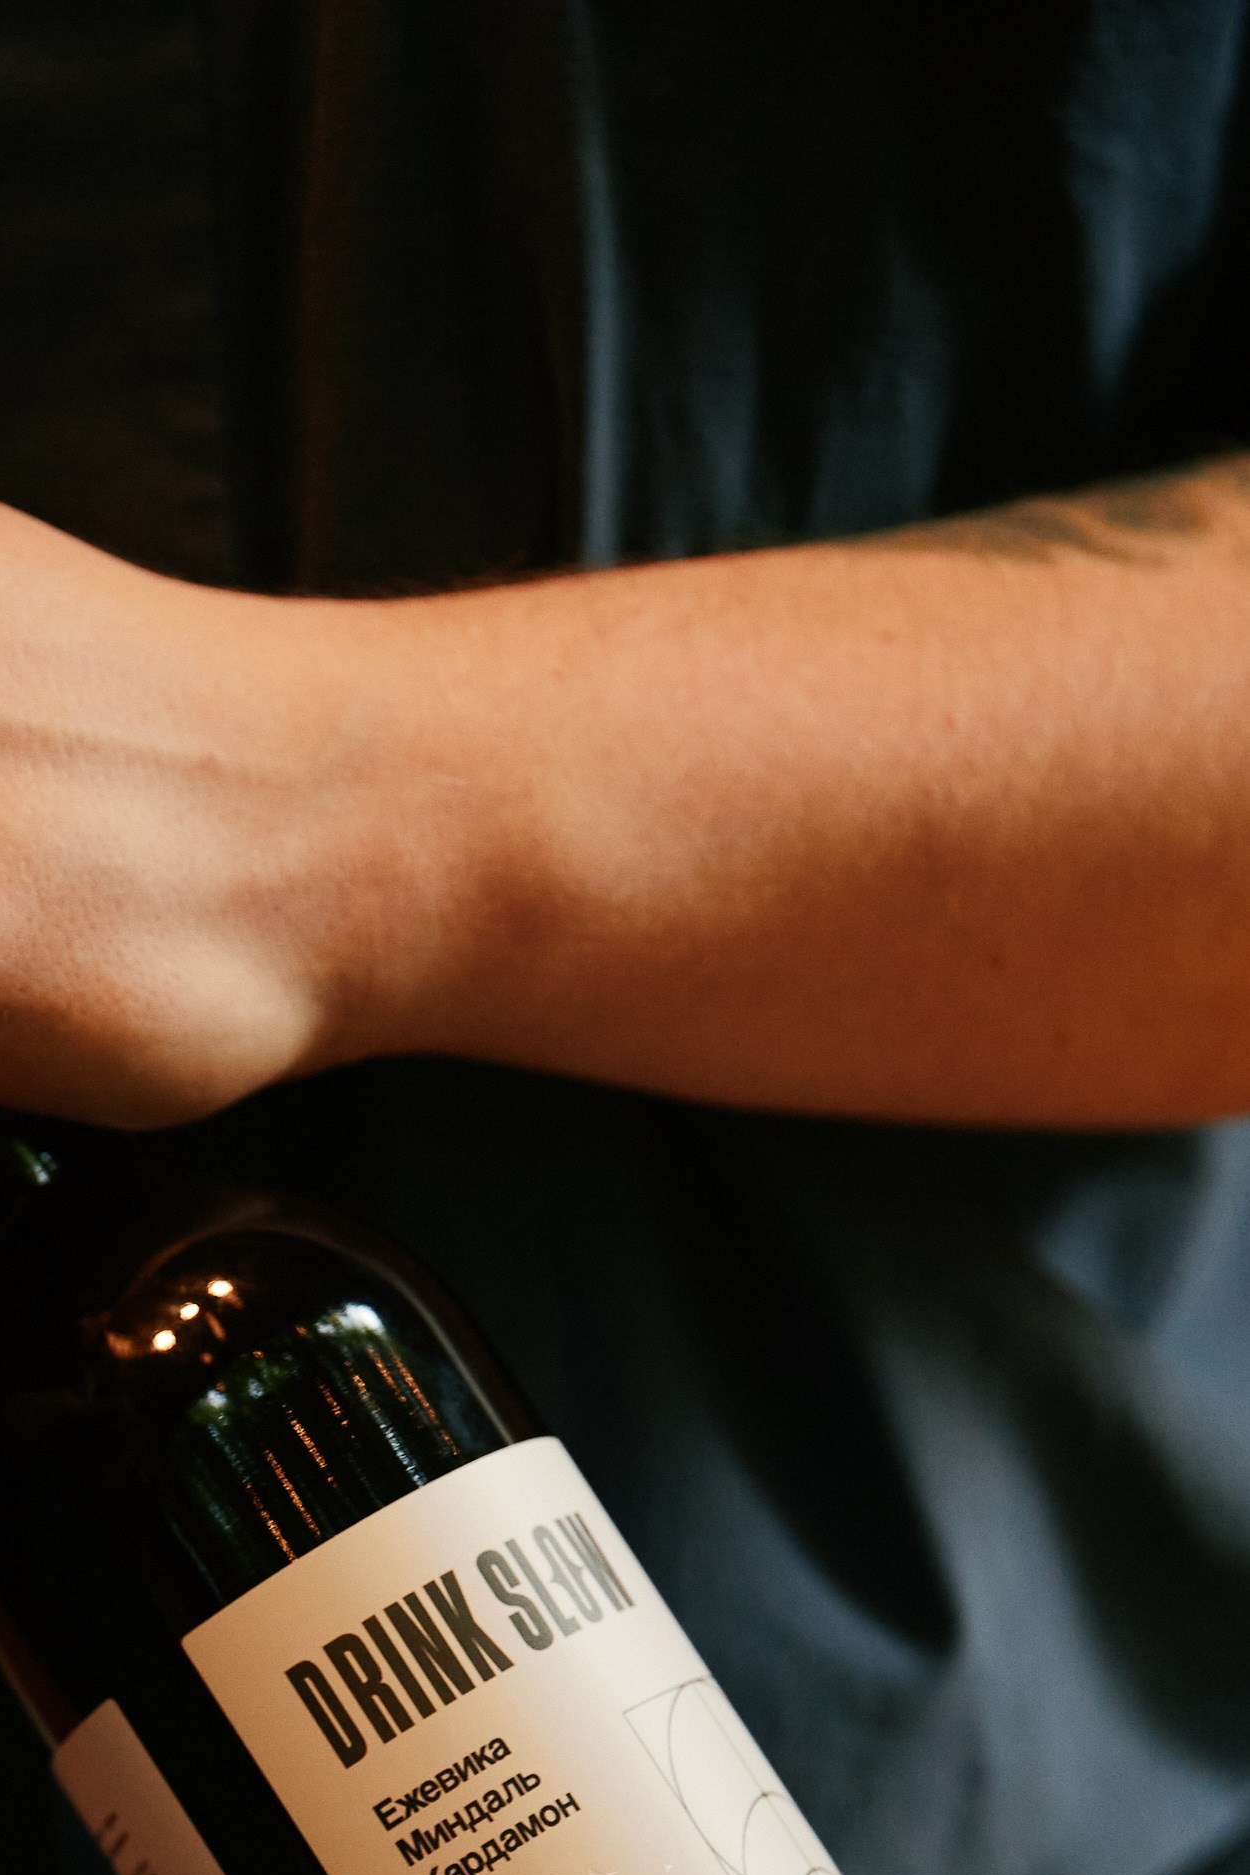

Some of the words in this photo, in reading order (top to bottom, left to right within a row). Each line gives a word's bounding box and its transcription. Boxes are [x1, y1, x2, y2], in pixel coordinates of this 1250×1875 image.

[285, 1569, 514, 1770] DRINK
[476, 1511, 634, 1652] SLOW
[372, 1737, 512, 1832] Ежевика
[395, 1772, 542, 1867] Миндаль
